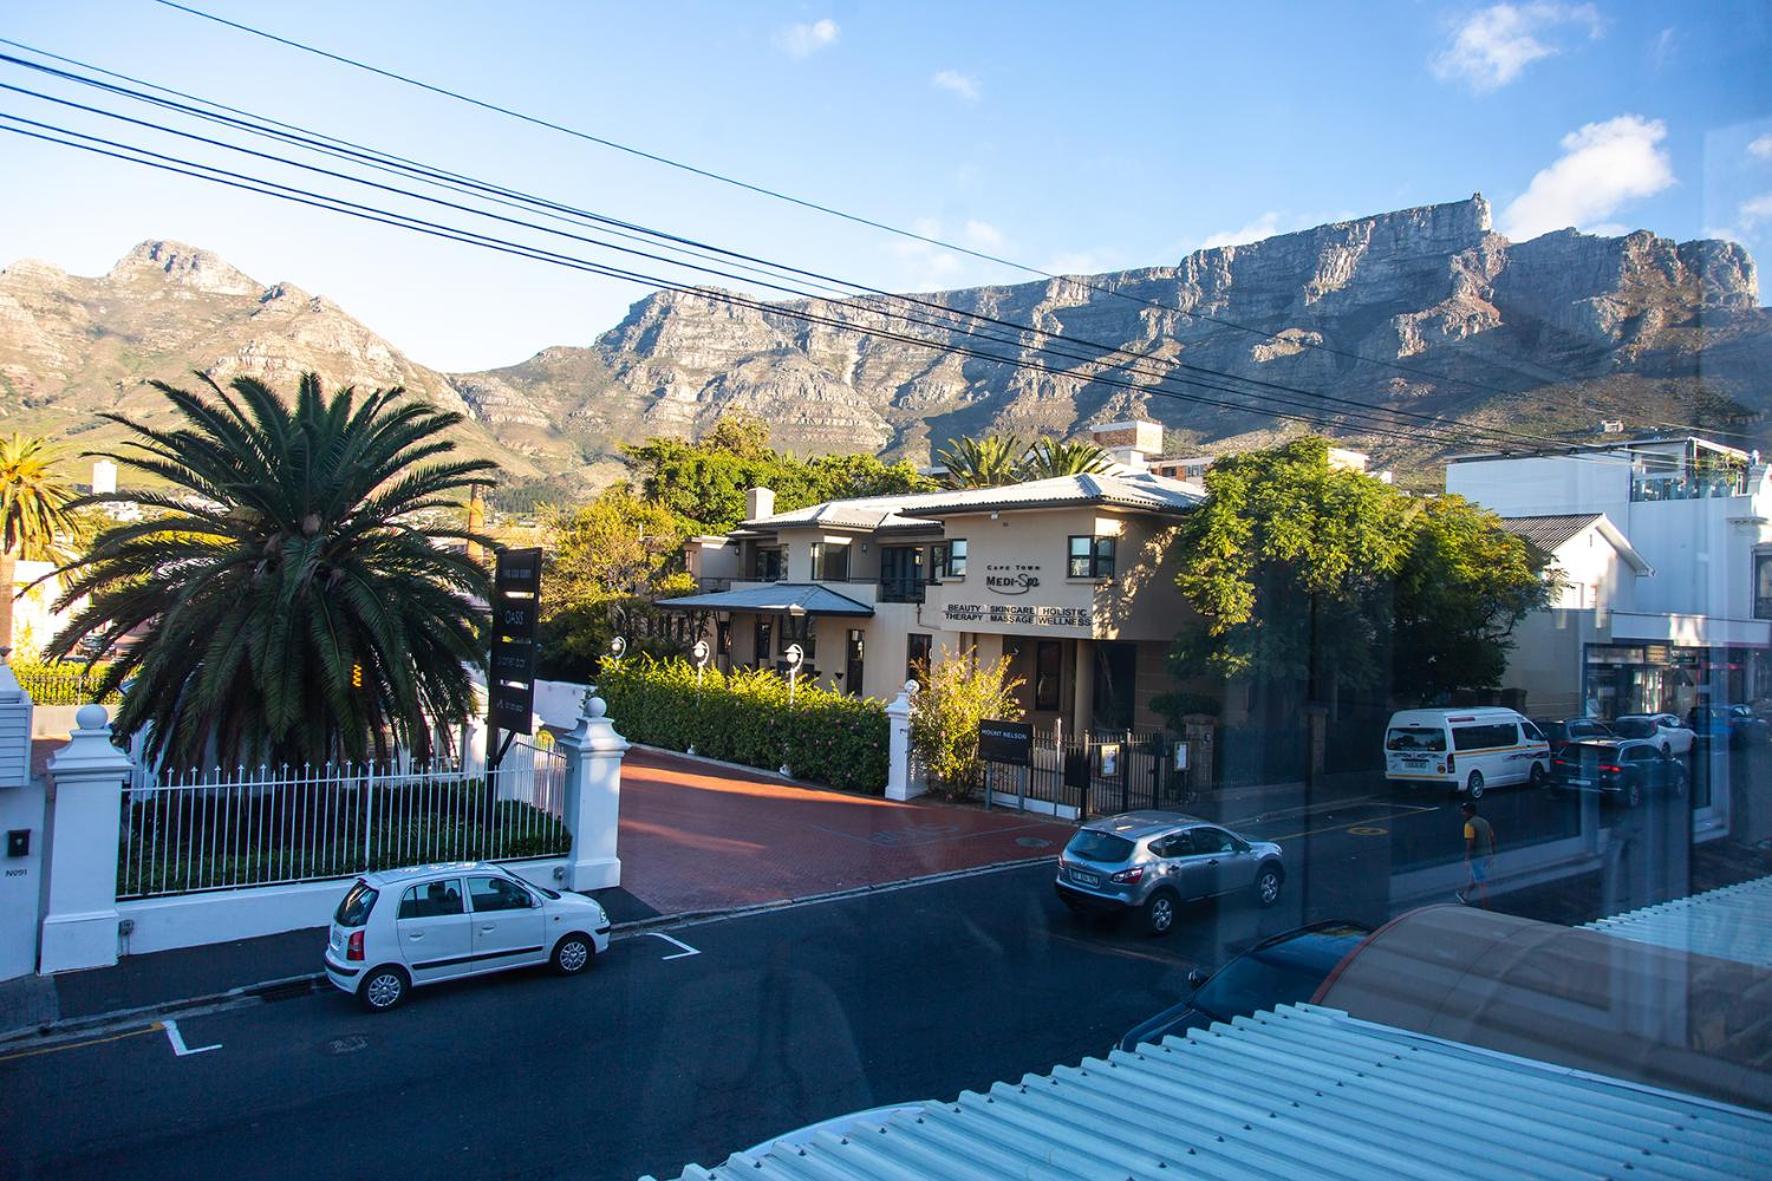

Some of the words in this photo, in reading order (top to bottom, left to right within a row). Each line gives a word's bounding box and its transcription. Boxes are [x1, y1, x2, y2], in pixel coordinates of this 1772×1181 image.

[948, 604, 981, 613] BEAUTY
[990, 605, 1036, 615] SKINCARE
[1042, 607, 1088, 617] HOLISTIC
[944, 611, 984, 621] THERAPY
[990, 614, 1034, 625] MASSAGE
[1038, 617, 1092, 627] WELLNESS
[981, 729, 1002, 737] MOUNT
[1002, 731, 1027, 740] NELSON
